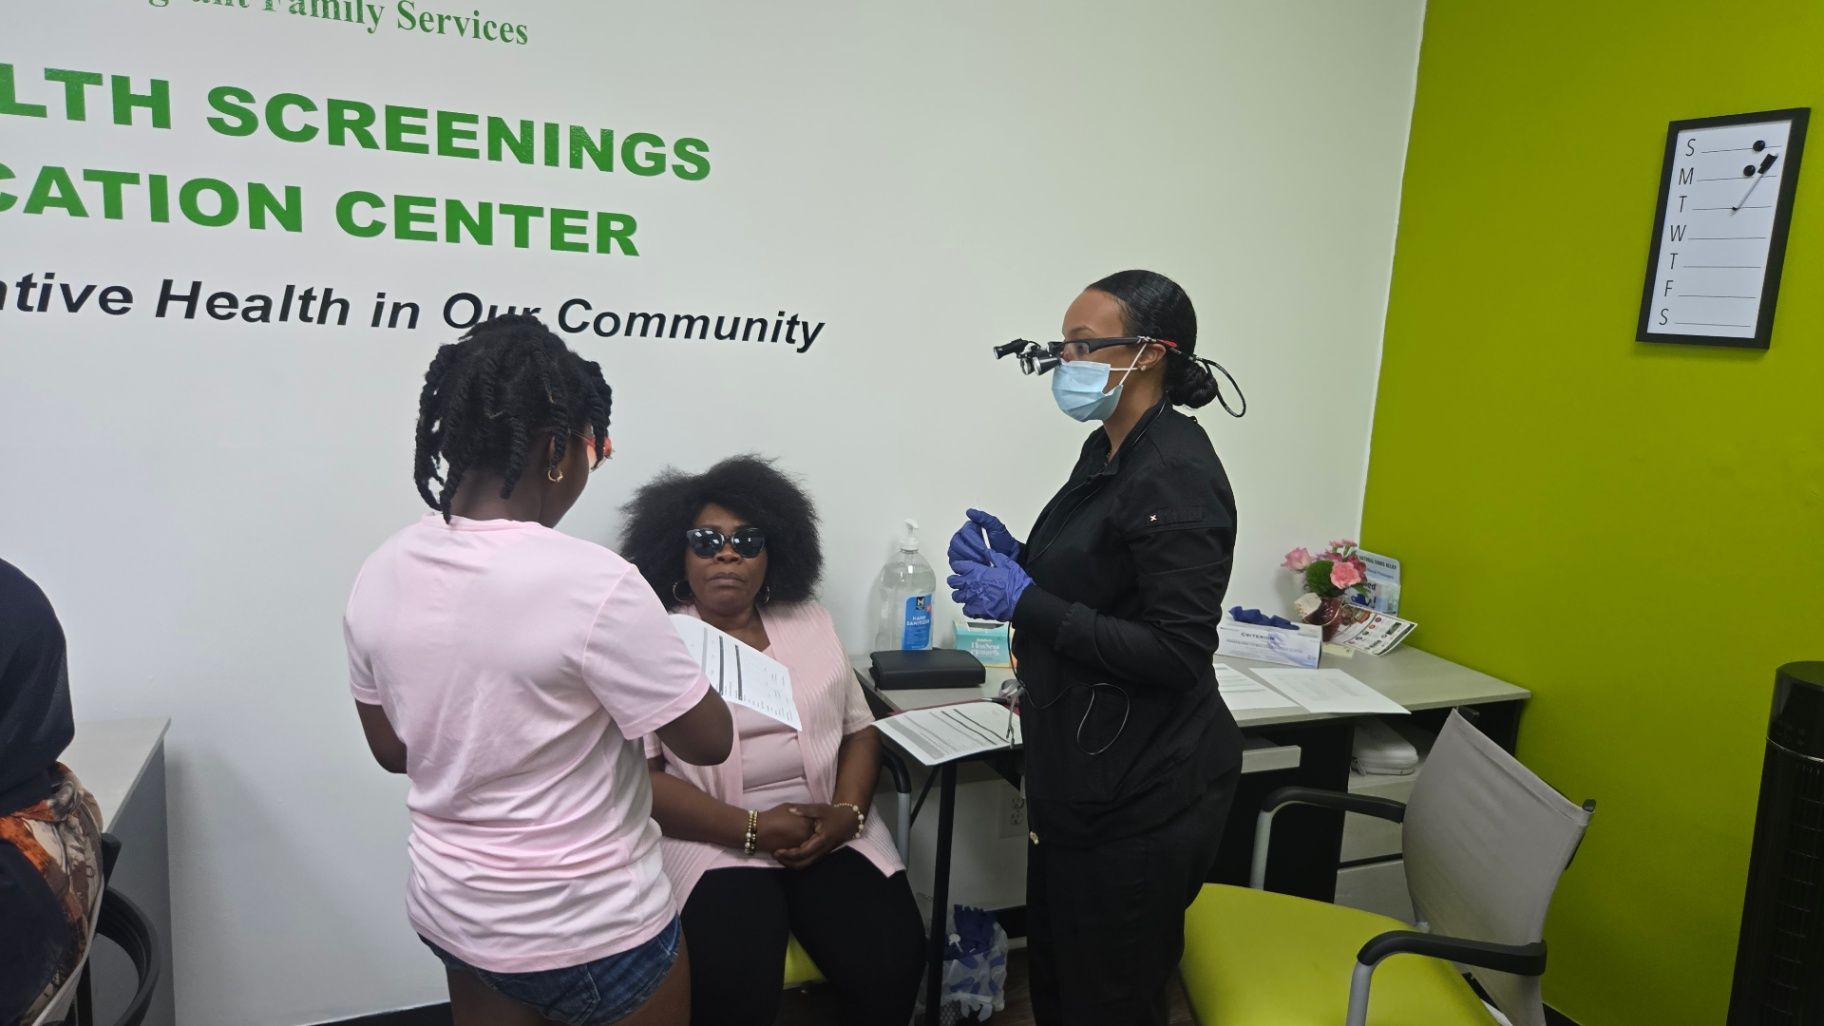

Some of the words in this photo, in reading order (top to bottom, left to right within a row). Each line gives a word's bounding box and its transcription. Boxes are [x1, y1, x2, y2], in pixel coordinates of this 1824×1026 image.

[397, 0, 528, 46] Services
[0, 62, 172, 130] LTH
[206, 85, 711, 181] SCREENINGS
[1685, 138, 1696, 157] S
[1678, 167, 1695, 186] M
[1679, 195, 1688, 213] T
[335, 190, 640, 257] CENTER
[1670, 224, 1687, 242] W
[1670, 252, 1679, 270] T
[1664, 279, 1674, 297] F
[0, 271, 134, 316] tive
[155, 278, 351, 326] Health
[370, 291, 420, 330] in
[557, 297, 826, 354] Community
[1658, 308, 1669, 326] S
